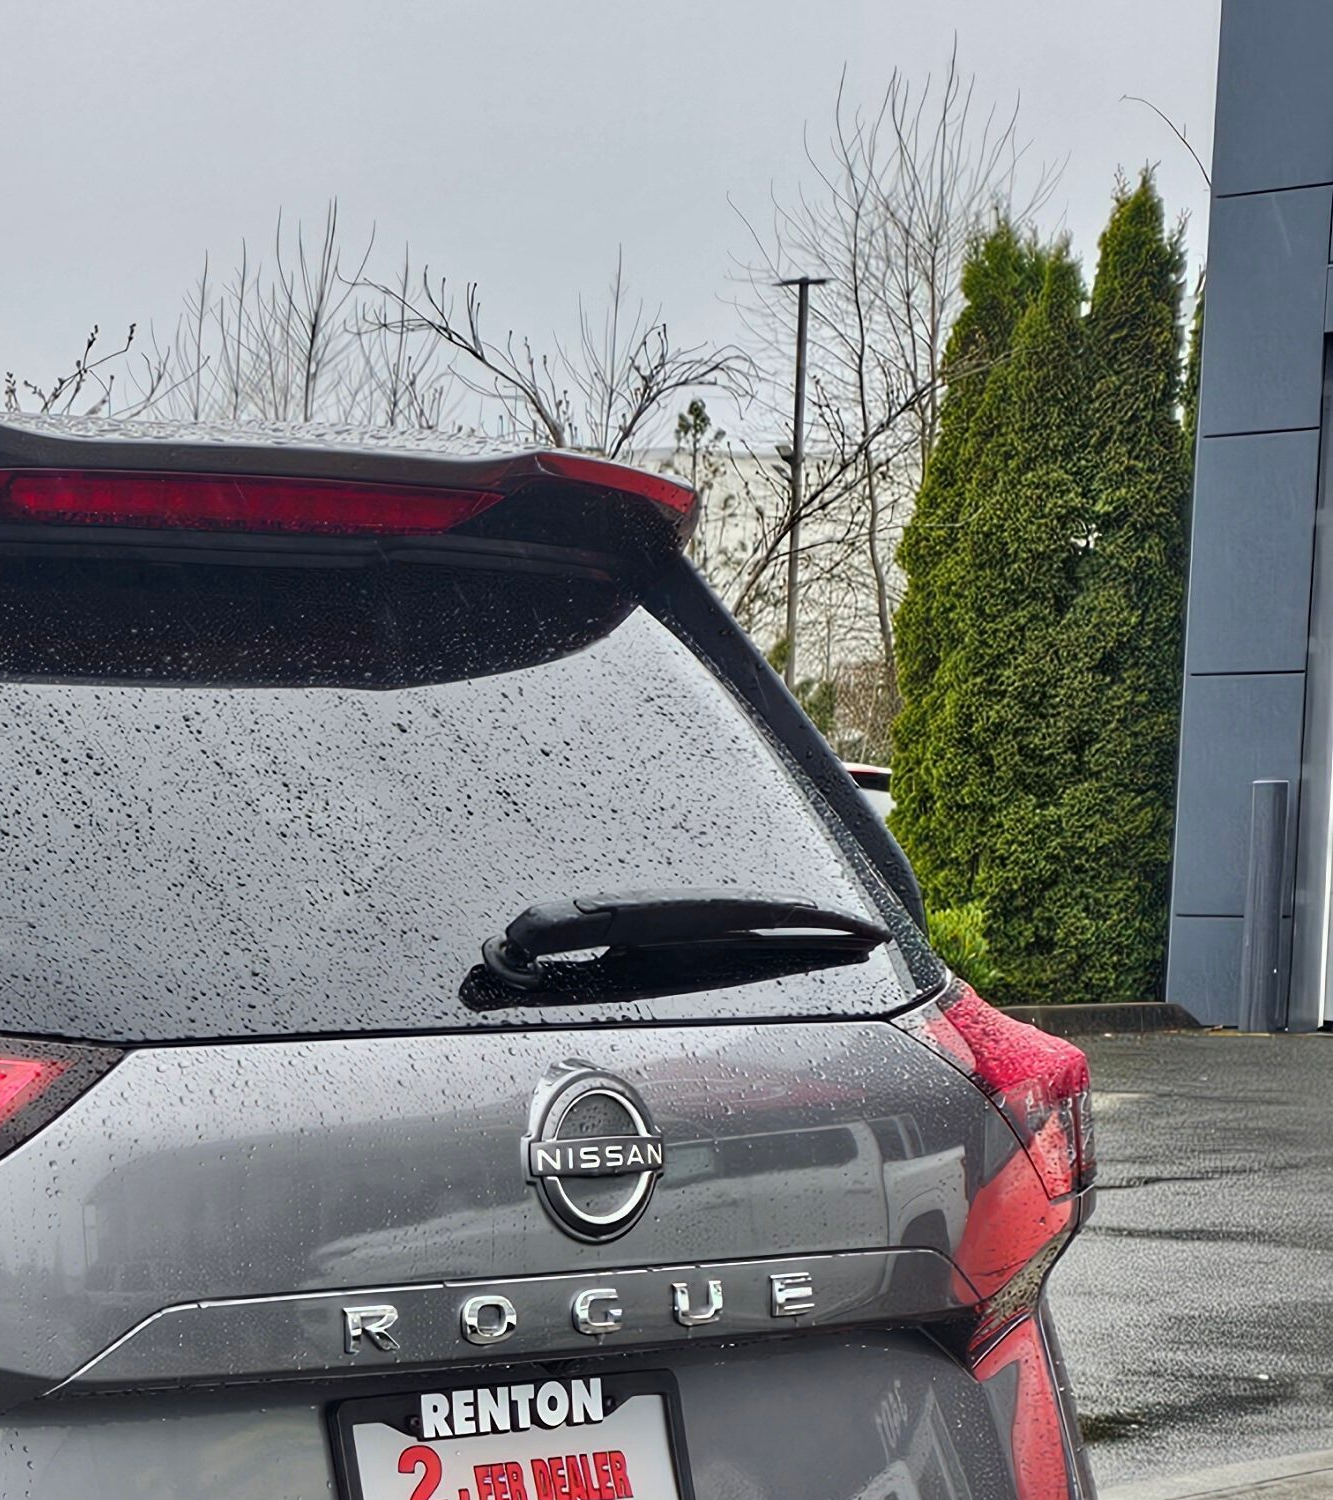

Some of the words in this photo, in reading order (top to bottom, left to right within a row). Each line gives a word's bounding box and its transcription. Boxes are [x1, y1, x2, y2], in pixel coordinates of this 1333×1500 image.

[536, 1142, 663, 1172] NISSAN
[342, 1272, 816, 1355] ROGUE
[420, 1377, 604, 1439] RENTON
